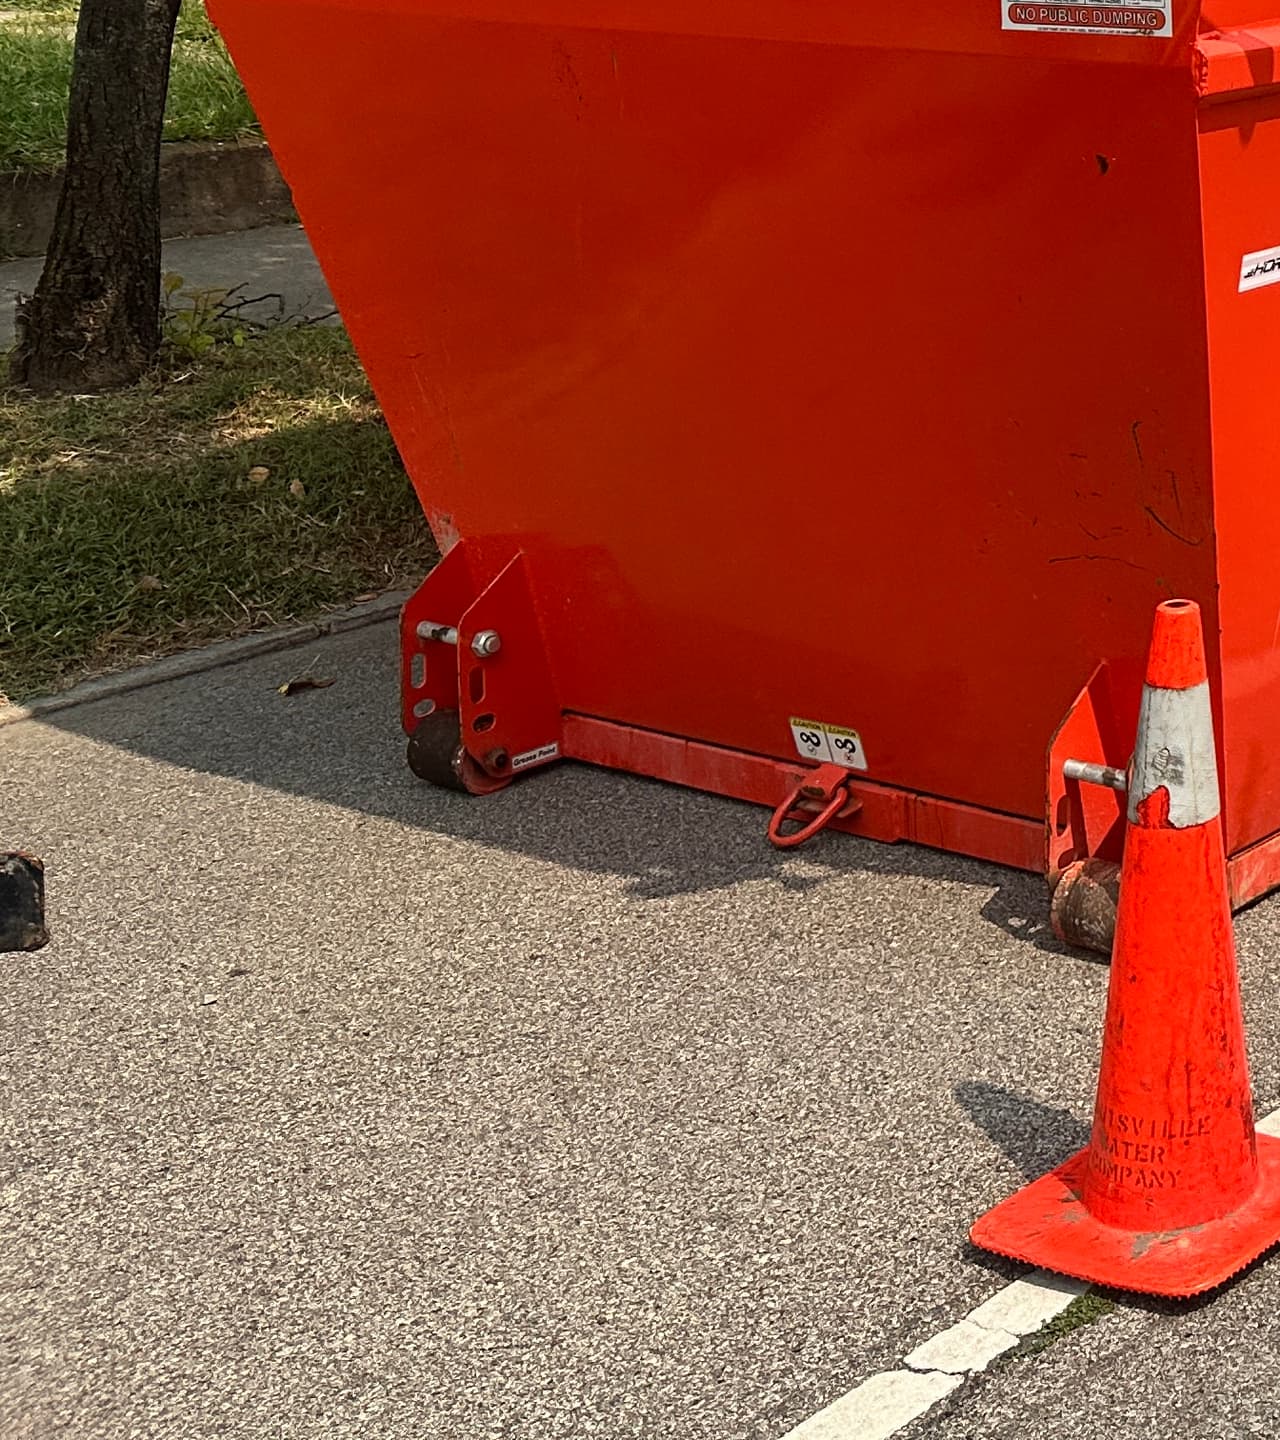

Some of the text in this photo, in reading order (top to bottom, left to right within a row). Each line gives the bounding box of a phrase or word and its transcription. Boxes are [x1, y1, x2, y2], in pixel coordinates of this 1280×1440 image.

[1016, 7, 1157, 26] NO PUBLIC DUMPING
[1103, 1109, 1211, 1139] ISVILLE
[1106, 1138, 1166, 1164] ATER
